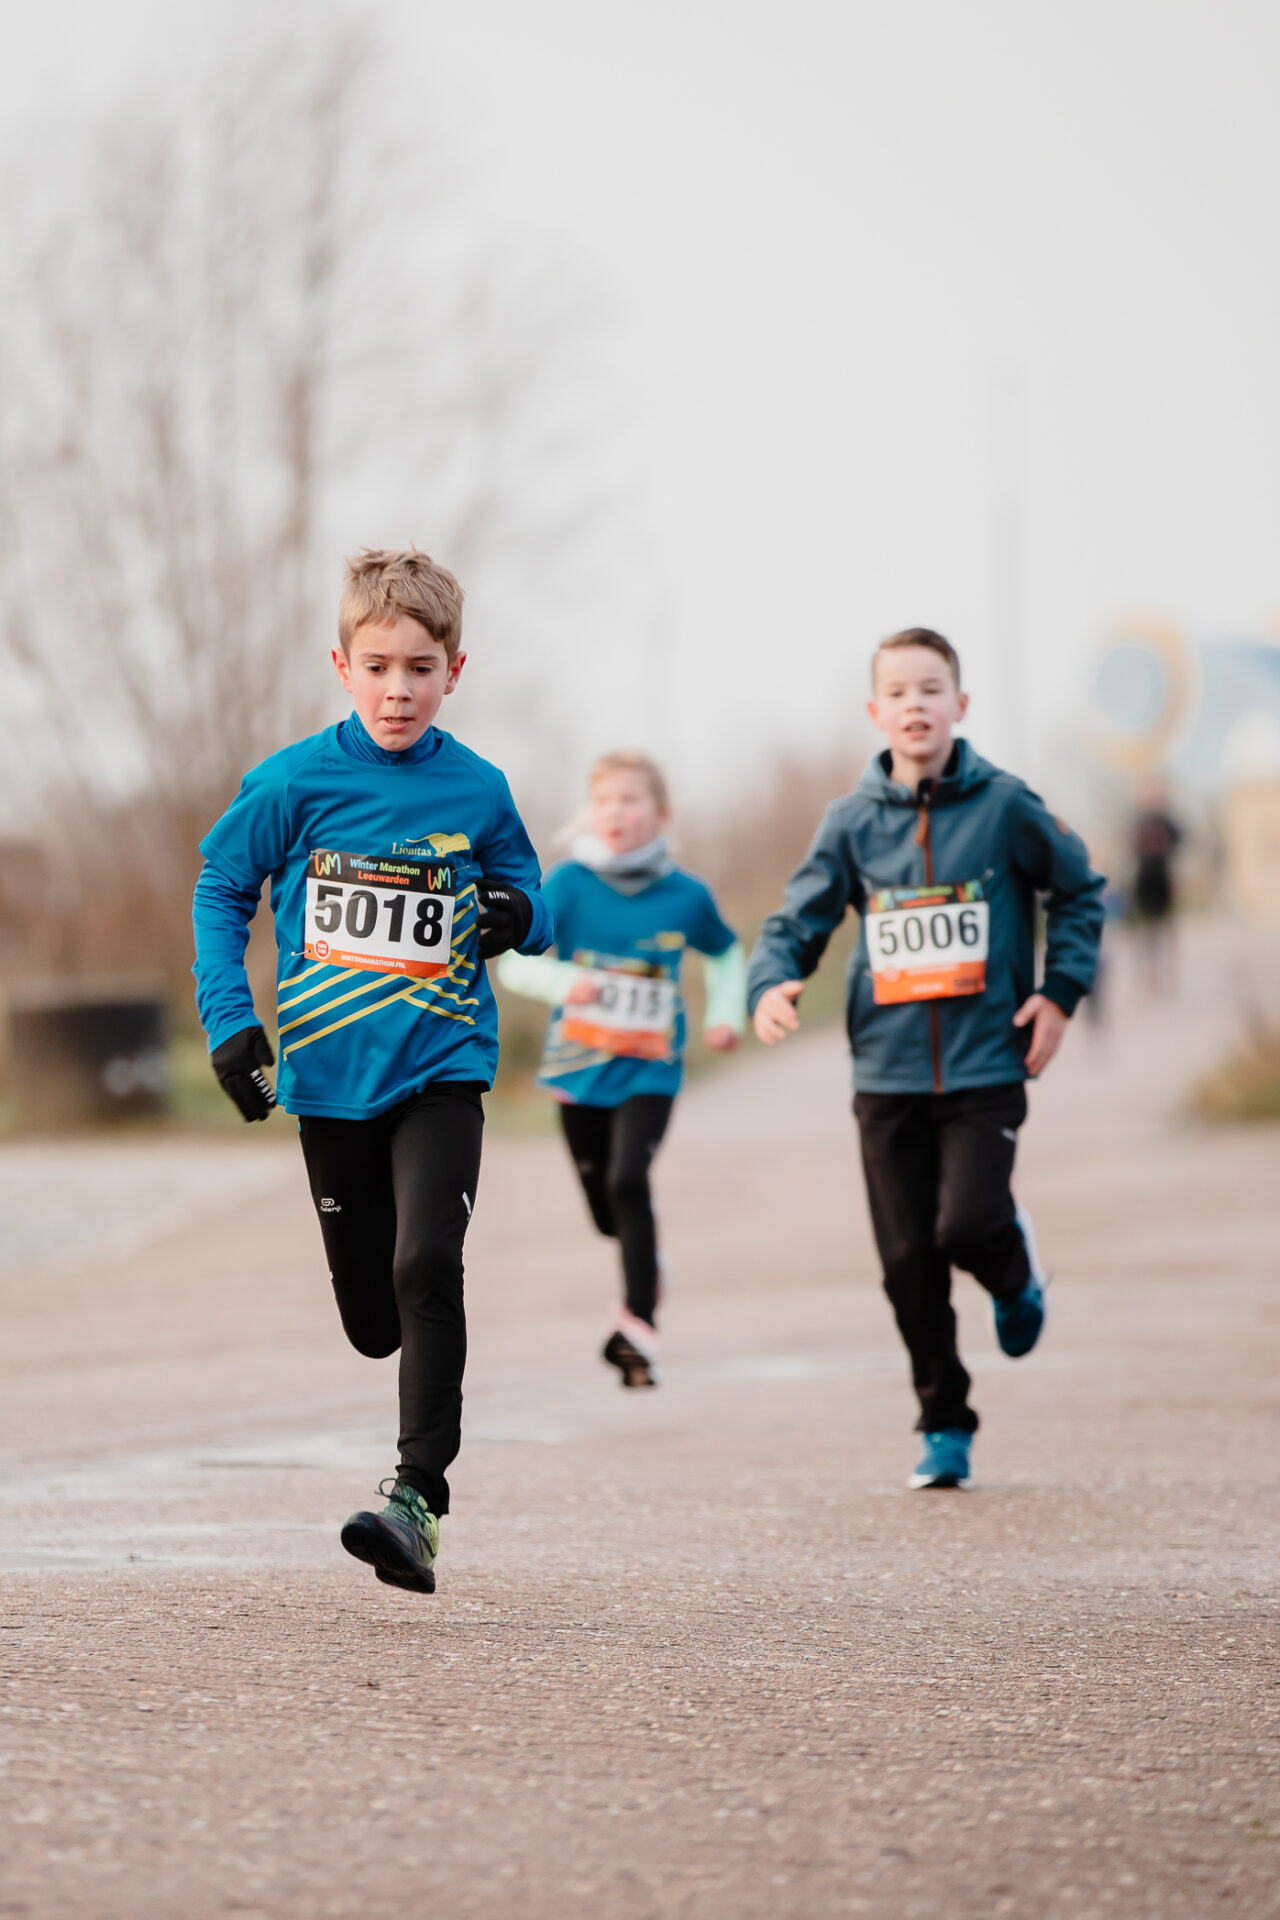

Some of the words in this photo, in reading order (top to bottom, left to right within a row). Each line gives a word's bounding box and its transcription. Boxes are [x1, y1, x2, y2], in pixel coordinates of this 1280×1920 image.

[392, 842, 432, 857] Lionitas
[350, 858, 378, 870] Winter
[379, 862, 420, 876] Marathon
[357, 870, 410, 885] Leeuwarden
[314, 884, 444, 947] 5018
[879, 909, 979, 956] 5006
